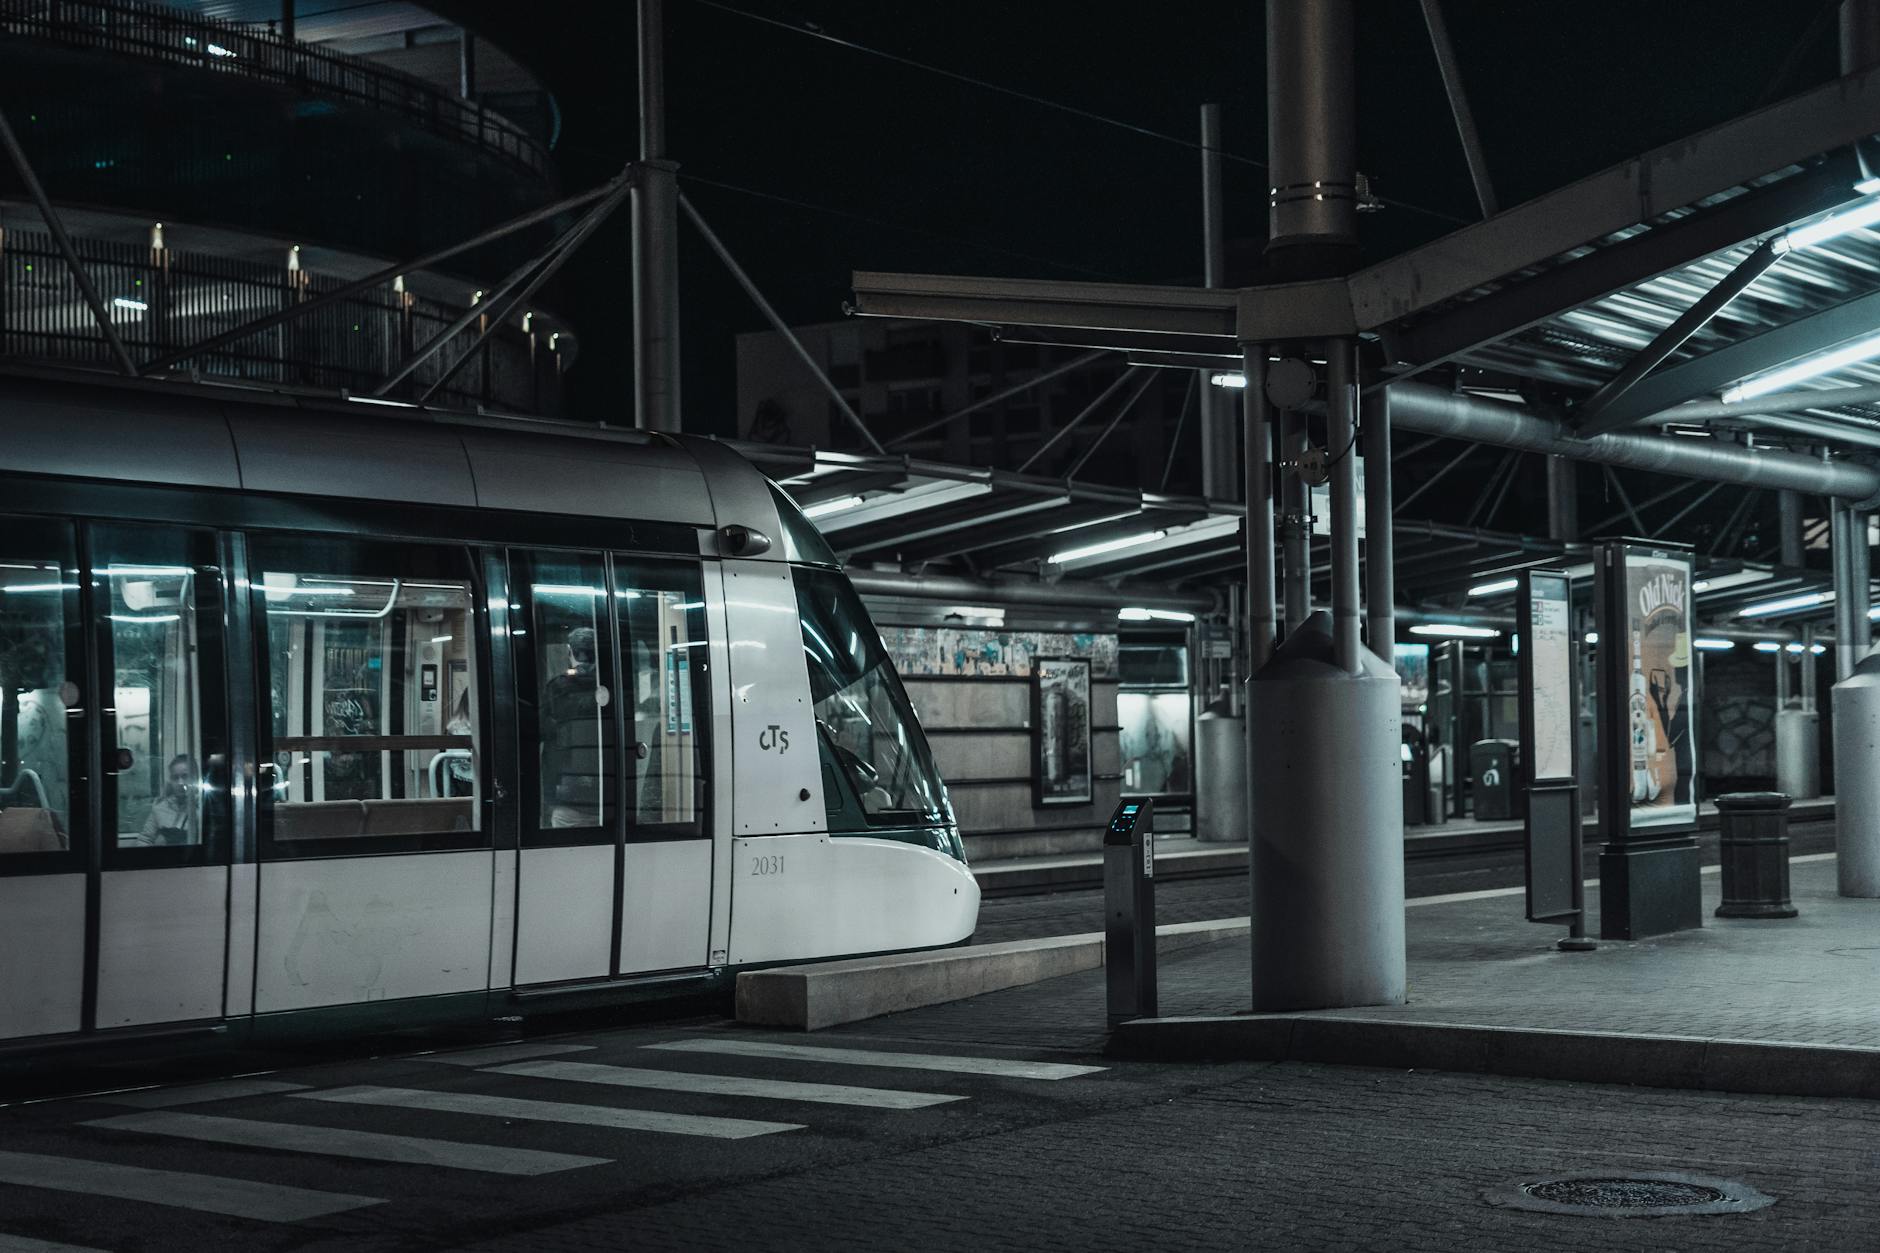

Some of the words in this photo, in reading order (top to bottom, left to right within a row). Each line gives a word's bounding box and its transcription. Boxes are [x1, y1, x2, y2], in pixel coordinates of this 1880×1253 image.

[1639, 575, 1660, 616] Old
[1661, 573, 1685, 612] Nick
[759, 724, 789, 754] CTS
[752, 855, 785, 876] 2031
